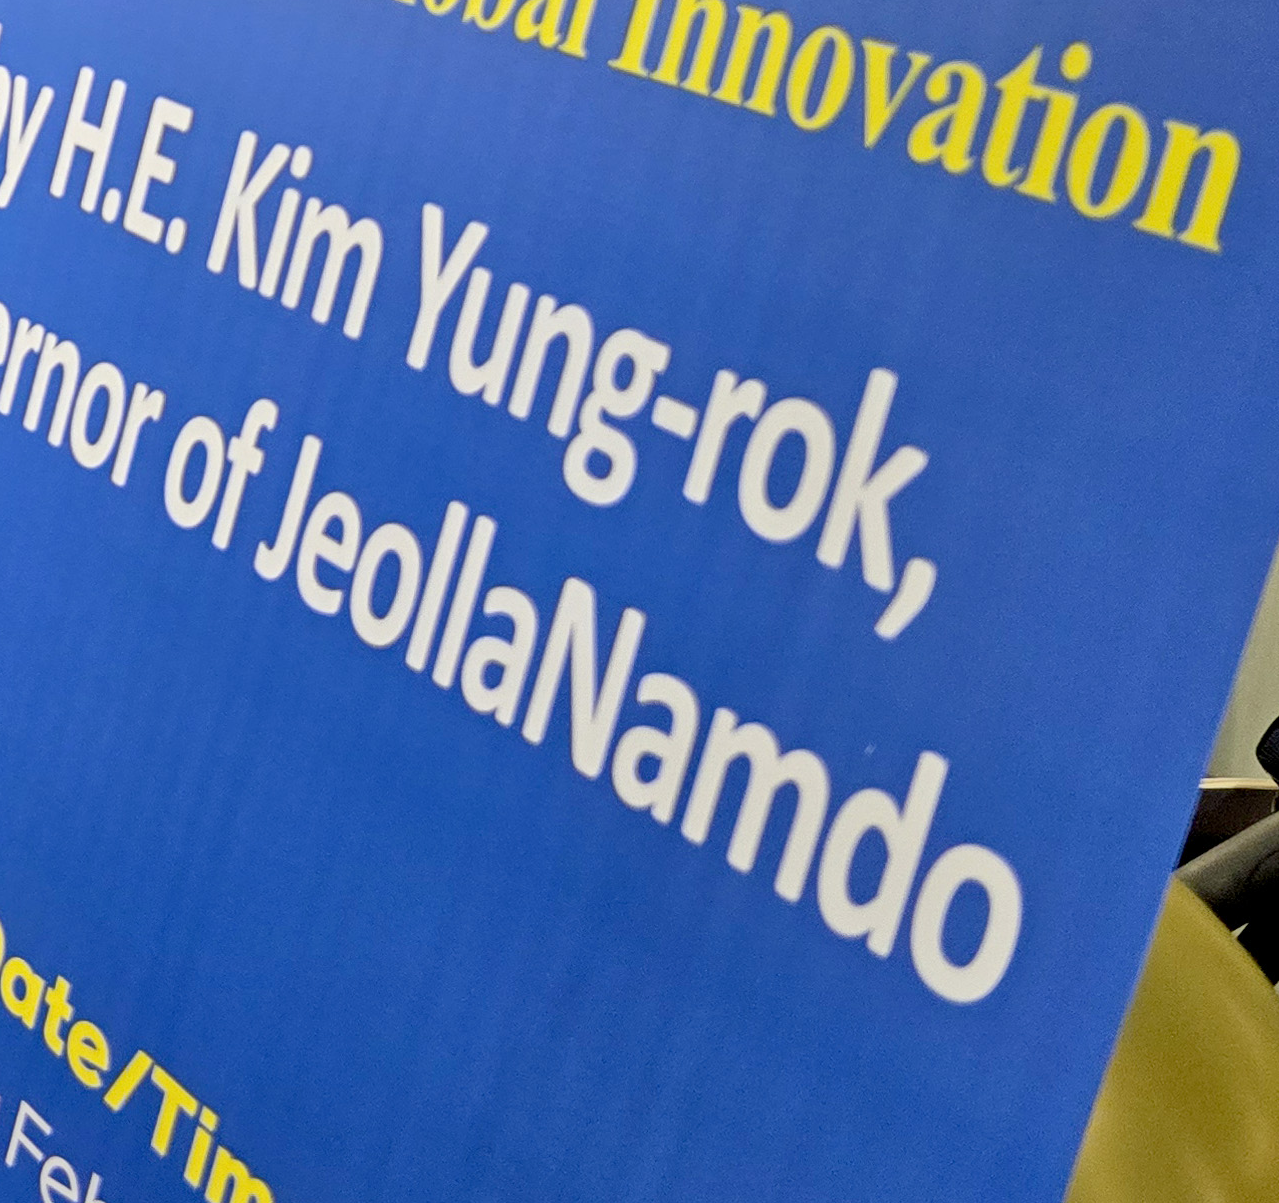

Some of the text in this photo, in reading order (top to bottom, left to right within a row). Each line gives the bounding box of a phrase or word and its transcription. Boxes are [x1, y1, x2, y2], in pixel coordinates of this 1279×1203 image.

[49, 66, 194, 254] H.E.
[206, 130, 384, 339] Kim
[406, 201, 938, 639] Yung-rok,
[164, 398, 279, 550] of
[254, 435, 1024, 1004] JeollaNamdo
